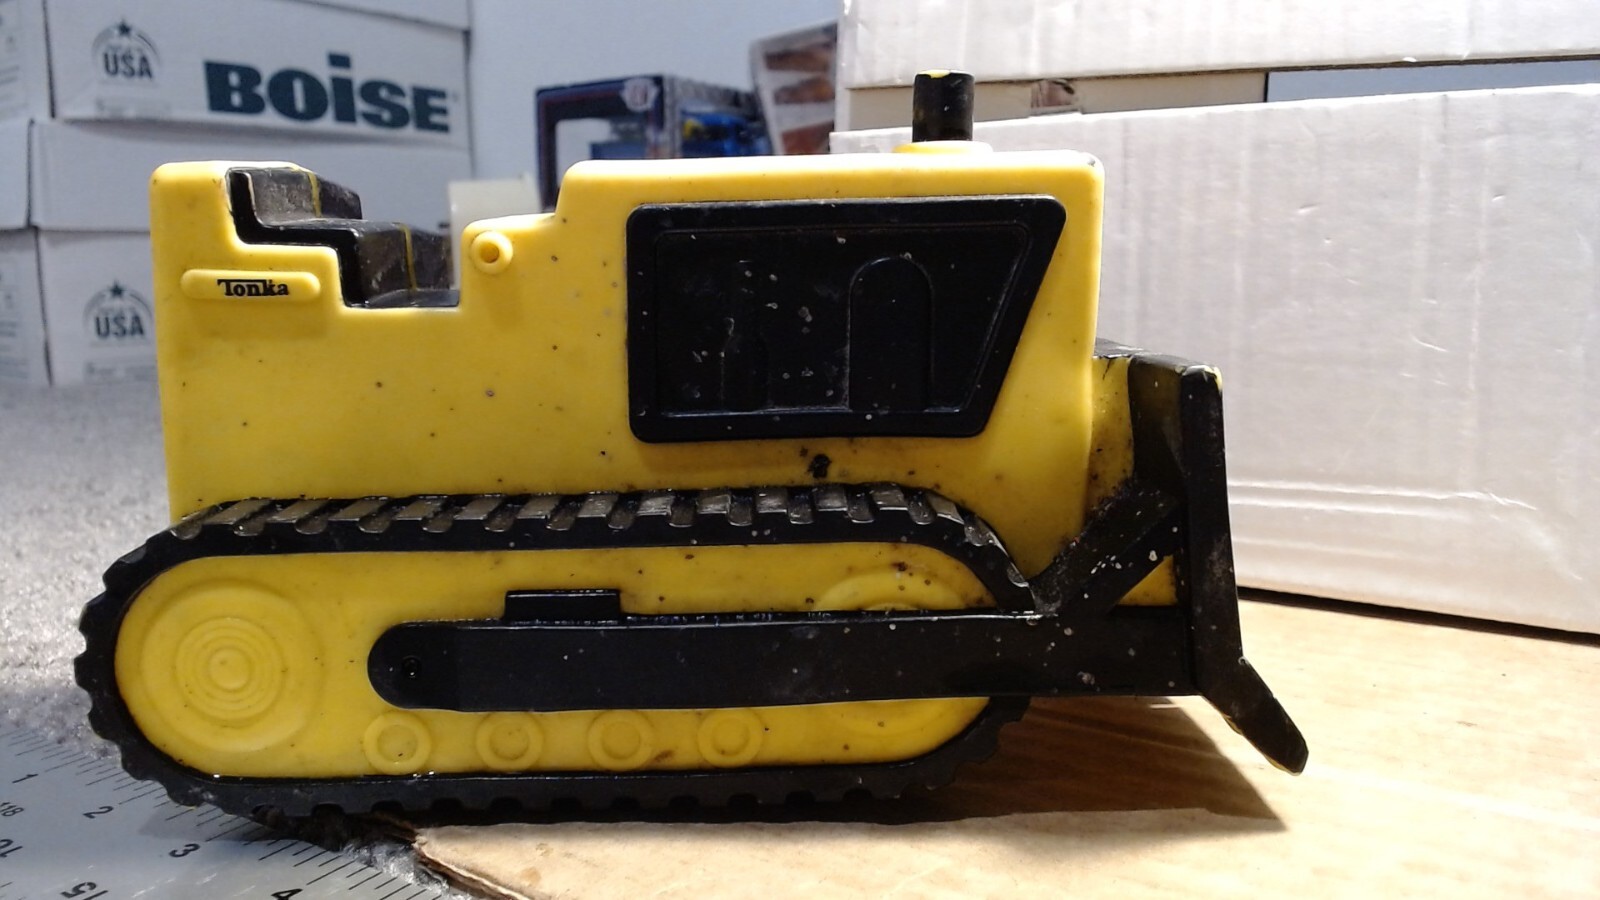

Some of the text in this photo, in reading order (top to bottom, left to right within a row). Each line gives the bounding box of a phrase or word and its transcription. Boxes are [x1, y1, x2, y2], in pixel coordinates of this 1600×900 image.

[103, 52, 152, 79] USA
[217, 279, 289, 297] Tonka
[95, 315, 144, 339] USA
[12, 773, 39, 783] 1
[83, 806, 114, 819] 2
[169, 843, 200, 858] 3
